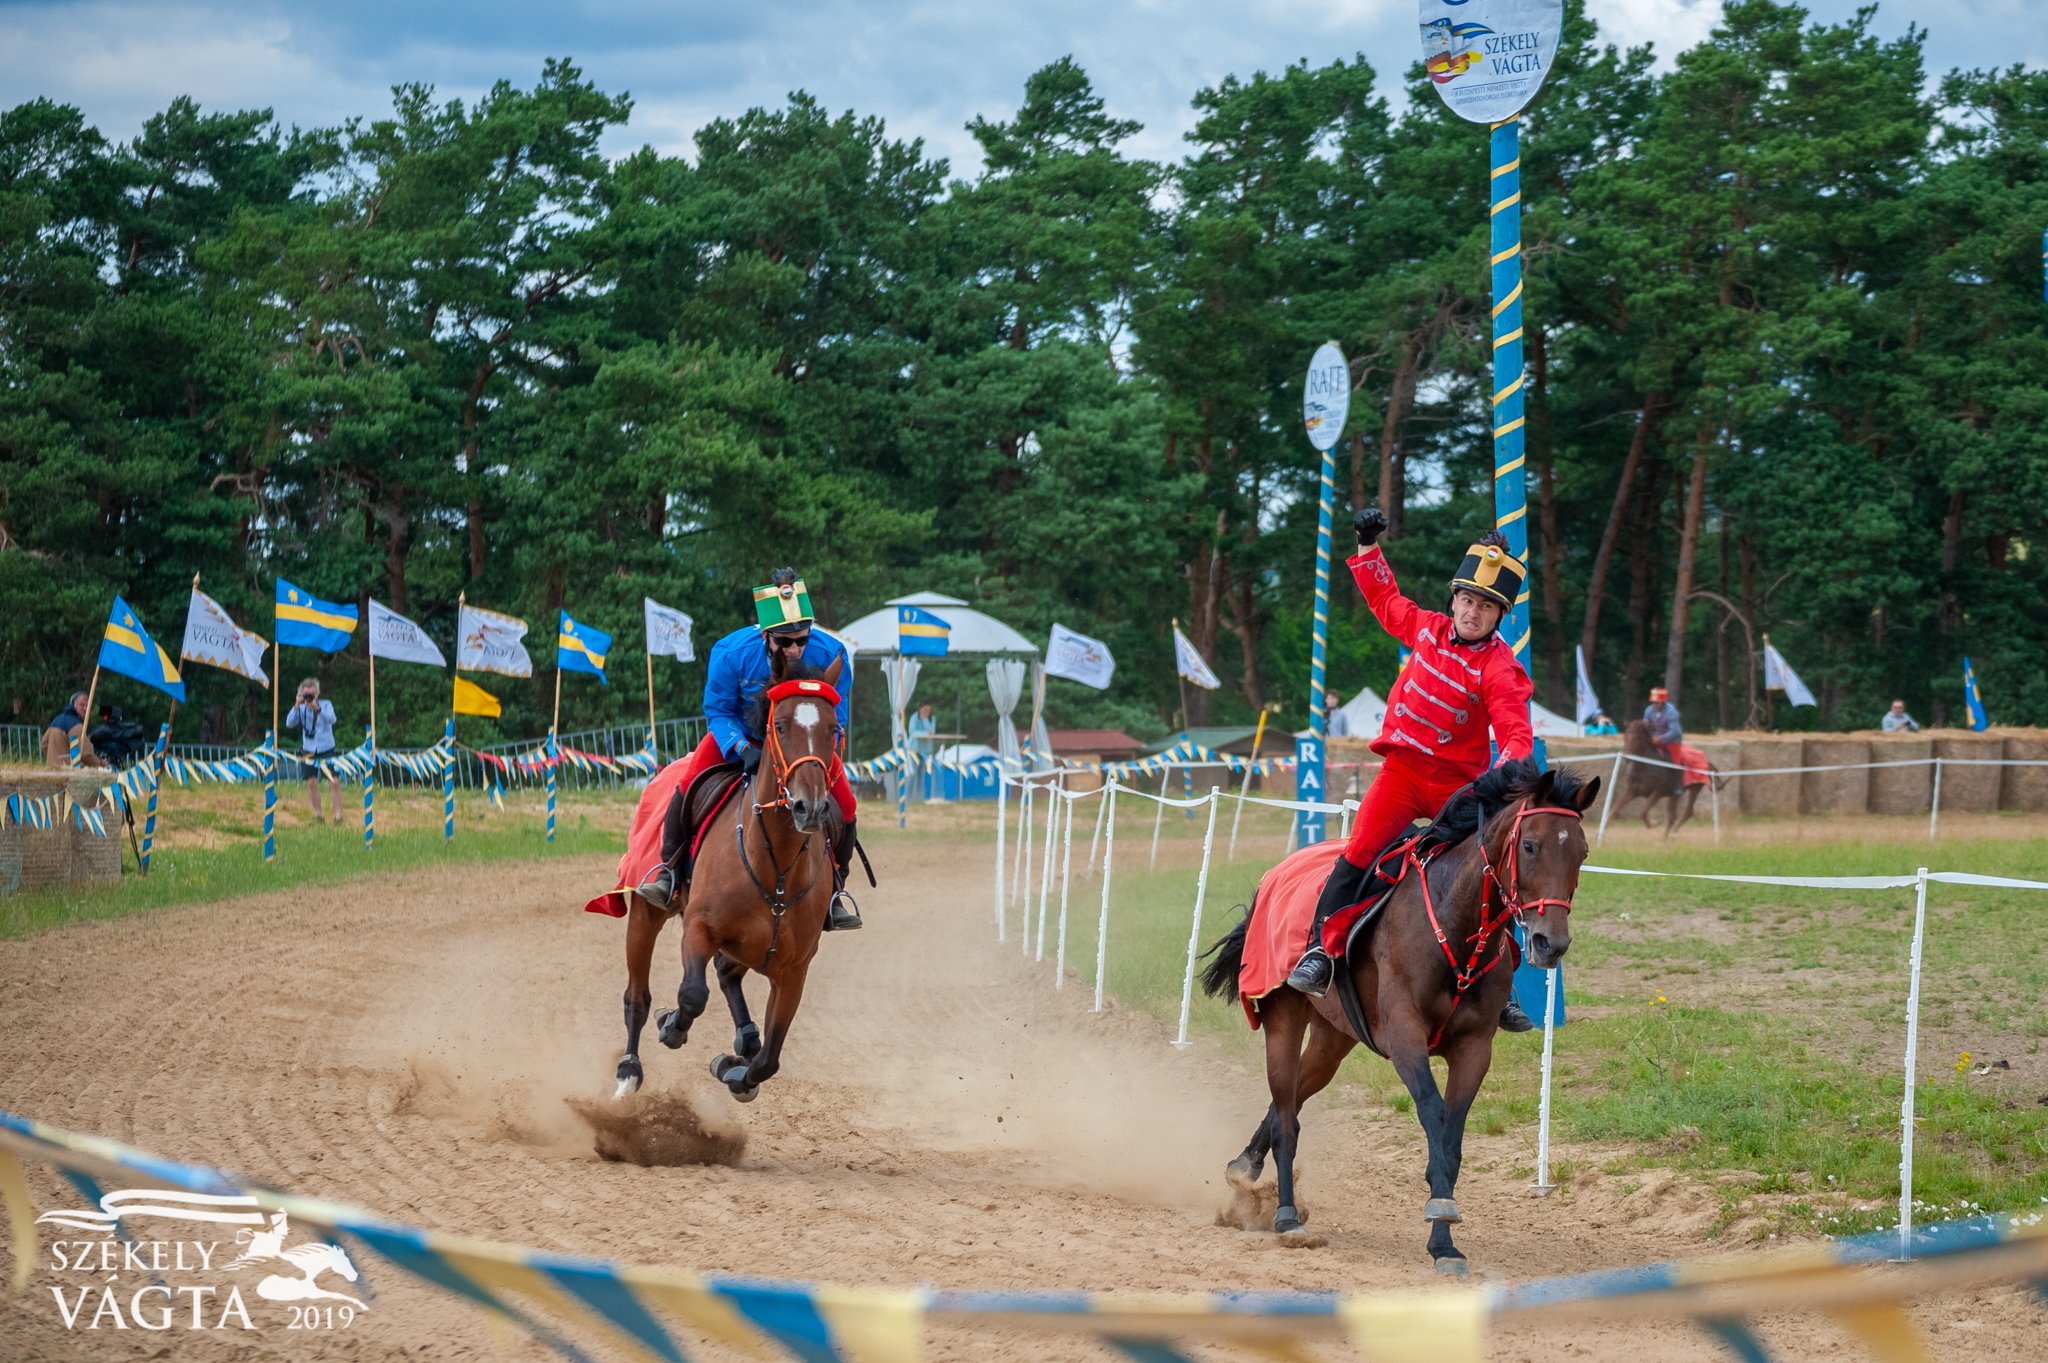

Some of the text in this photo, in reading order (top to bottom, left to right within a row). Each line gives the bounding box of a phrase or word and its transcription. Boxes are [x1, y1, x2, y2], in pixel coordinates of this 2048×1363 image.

[1485, 32, 1540, 55] SZÉKELY
[1492, 53, 1542, 76] VÁGTA
[1310, 366, 1343, 400] RAJT
[1300, 742, 1320, 844] RAJT
